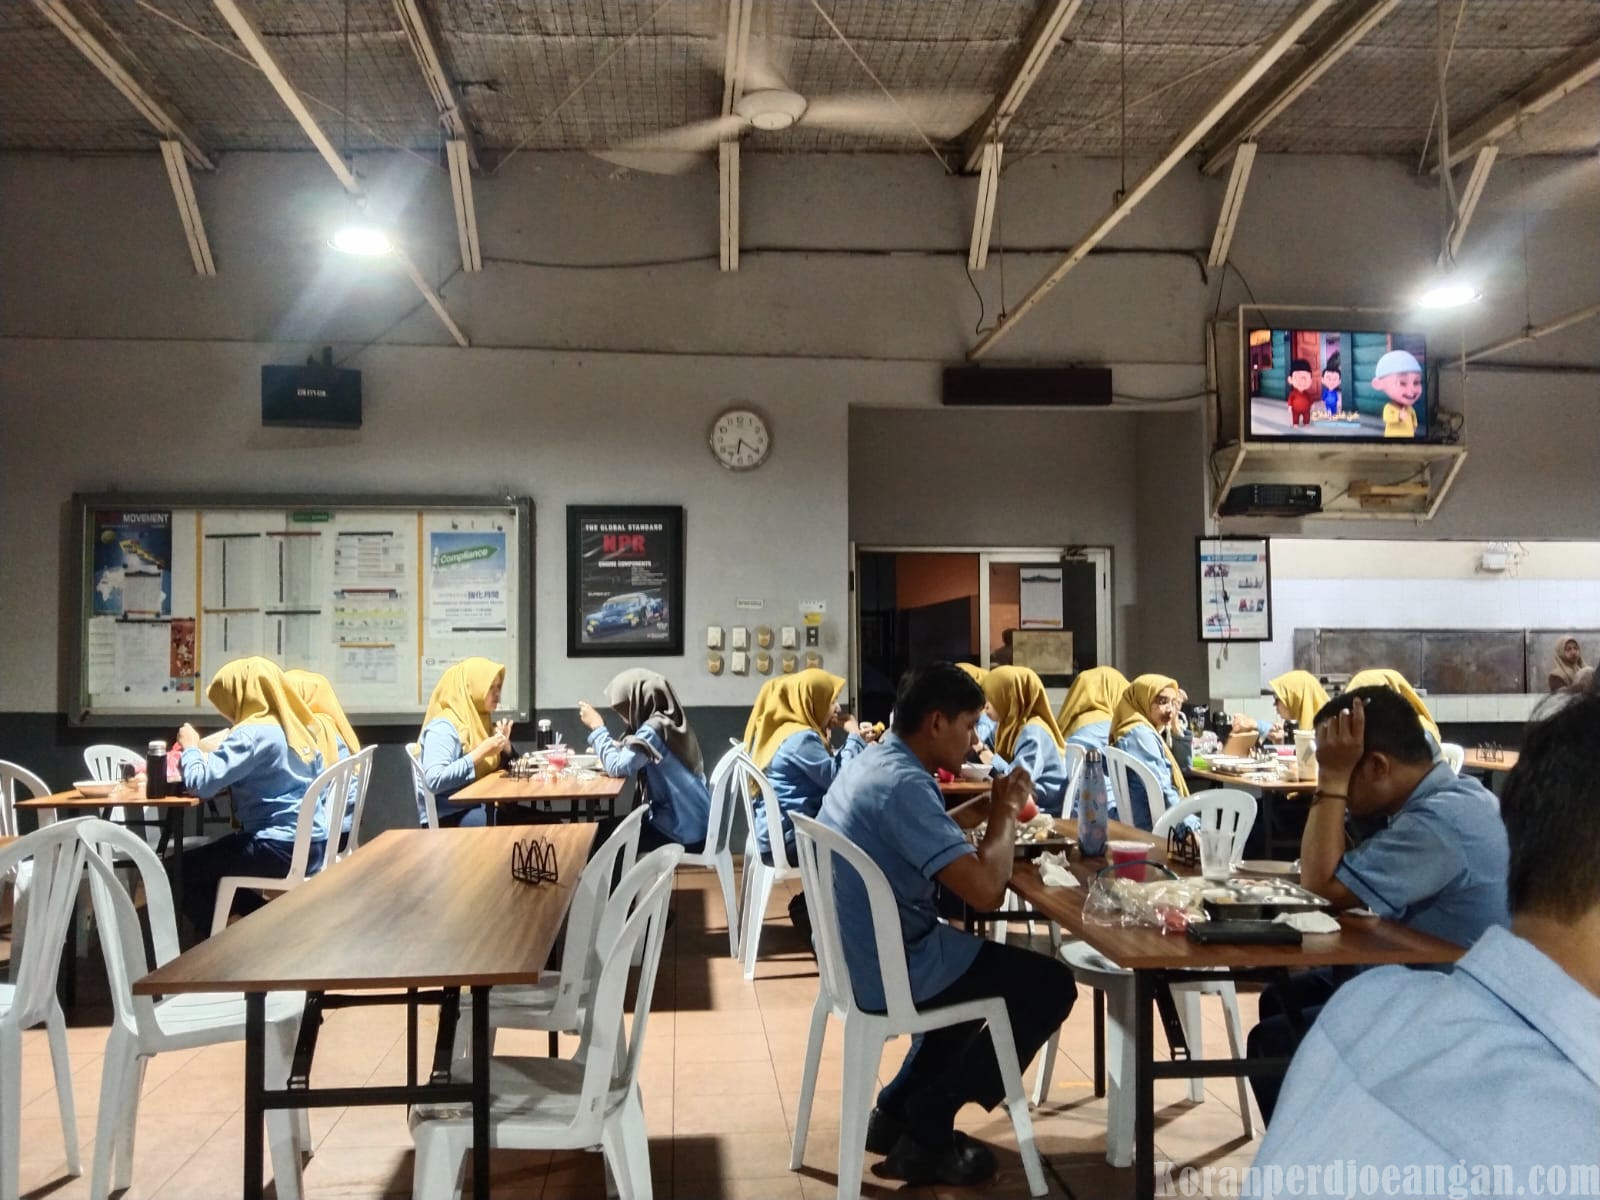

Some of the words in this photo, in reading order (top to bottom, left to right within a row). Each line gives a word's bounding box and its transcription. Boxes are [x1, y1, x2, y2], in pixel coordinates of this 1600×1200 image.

[123, 513, 168, 524] MOVEMENT
[585, 524, 598, 532] THE
[600, 524, 626, 532] GLOBAL
[628, 523, 663, 532] STANDARD
[440, 547, 489, 565] Compliance
